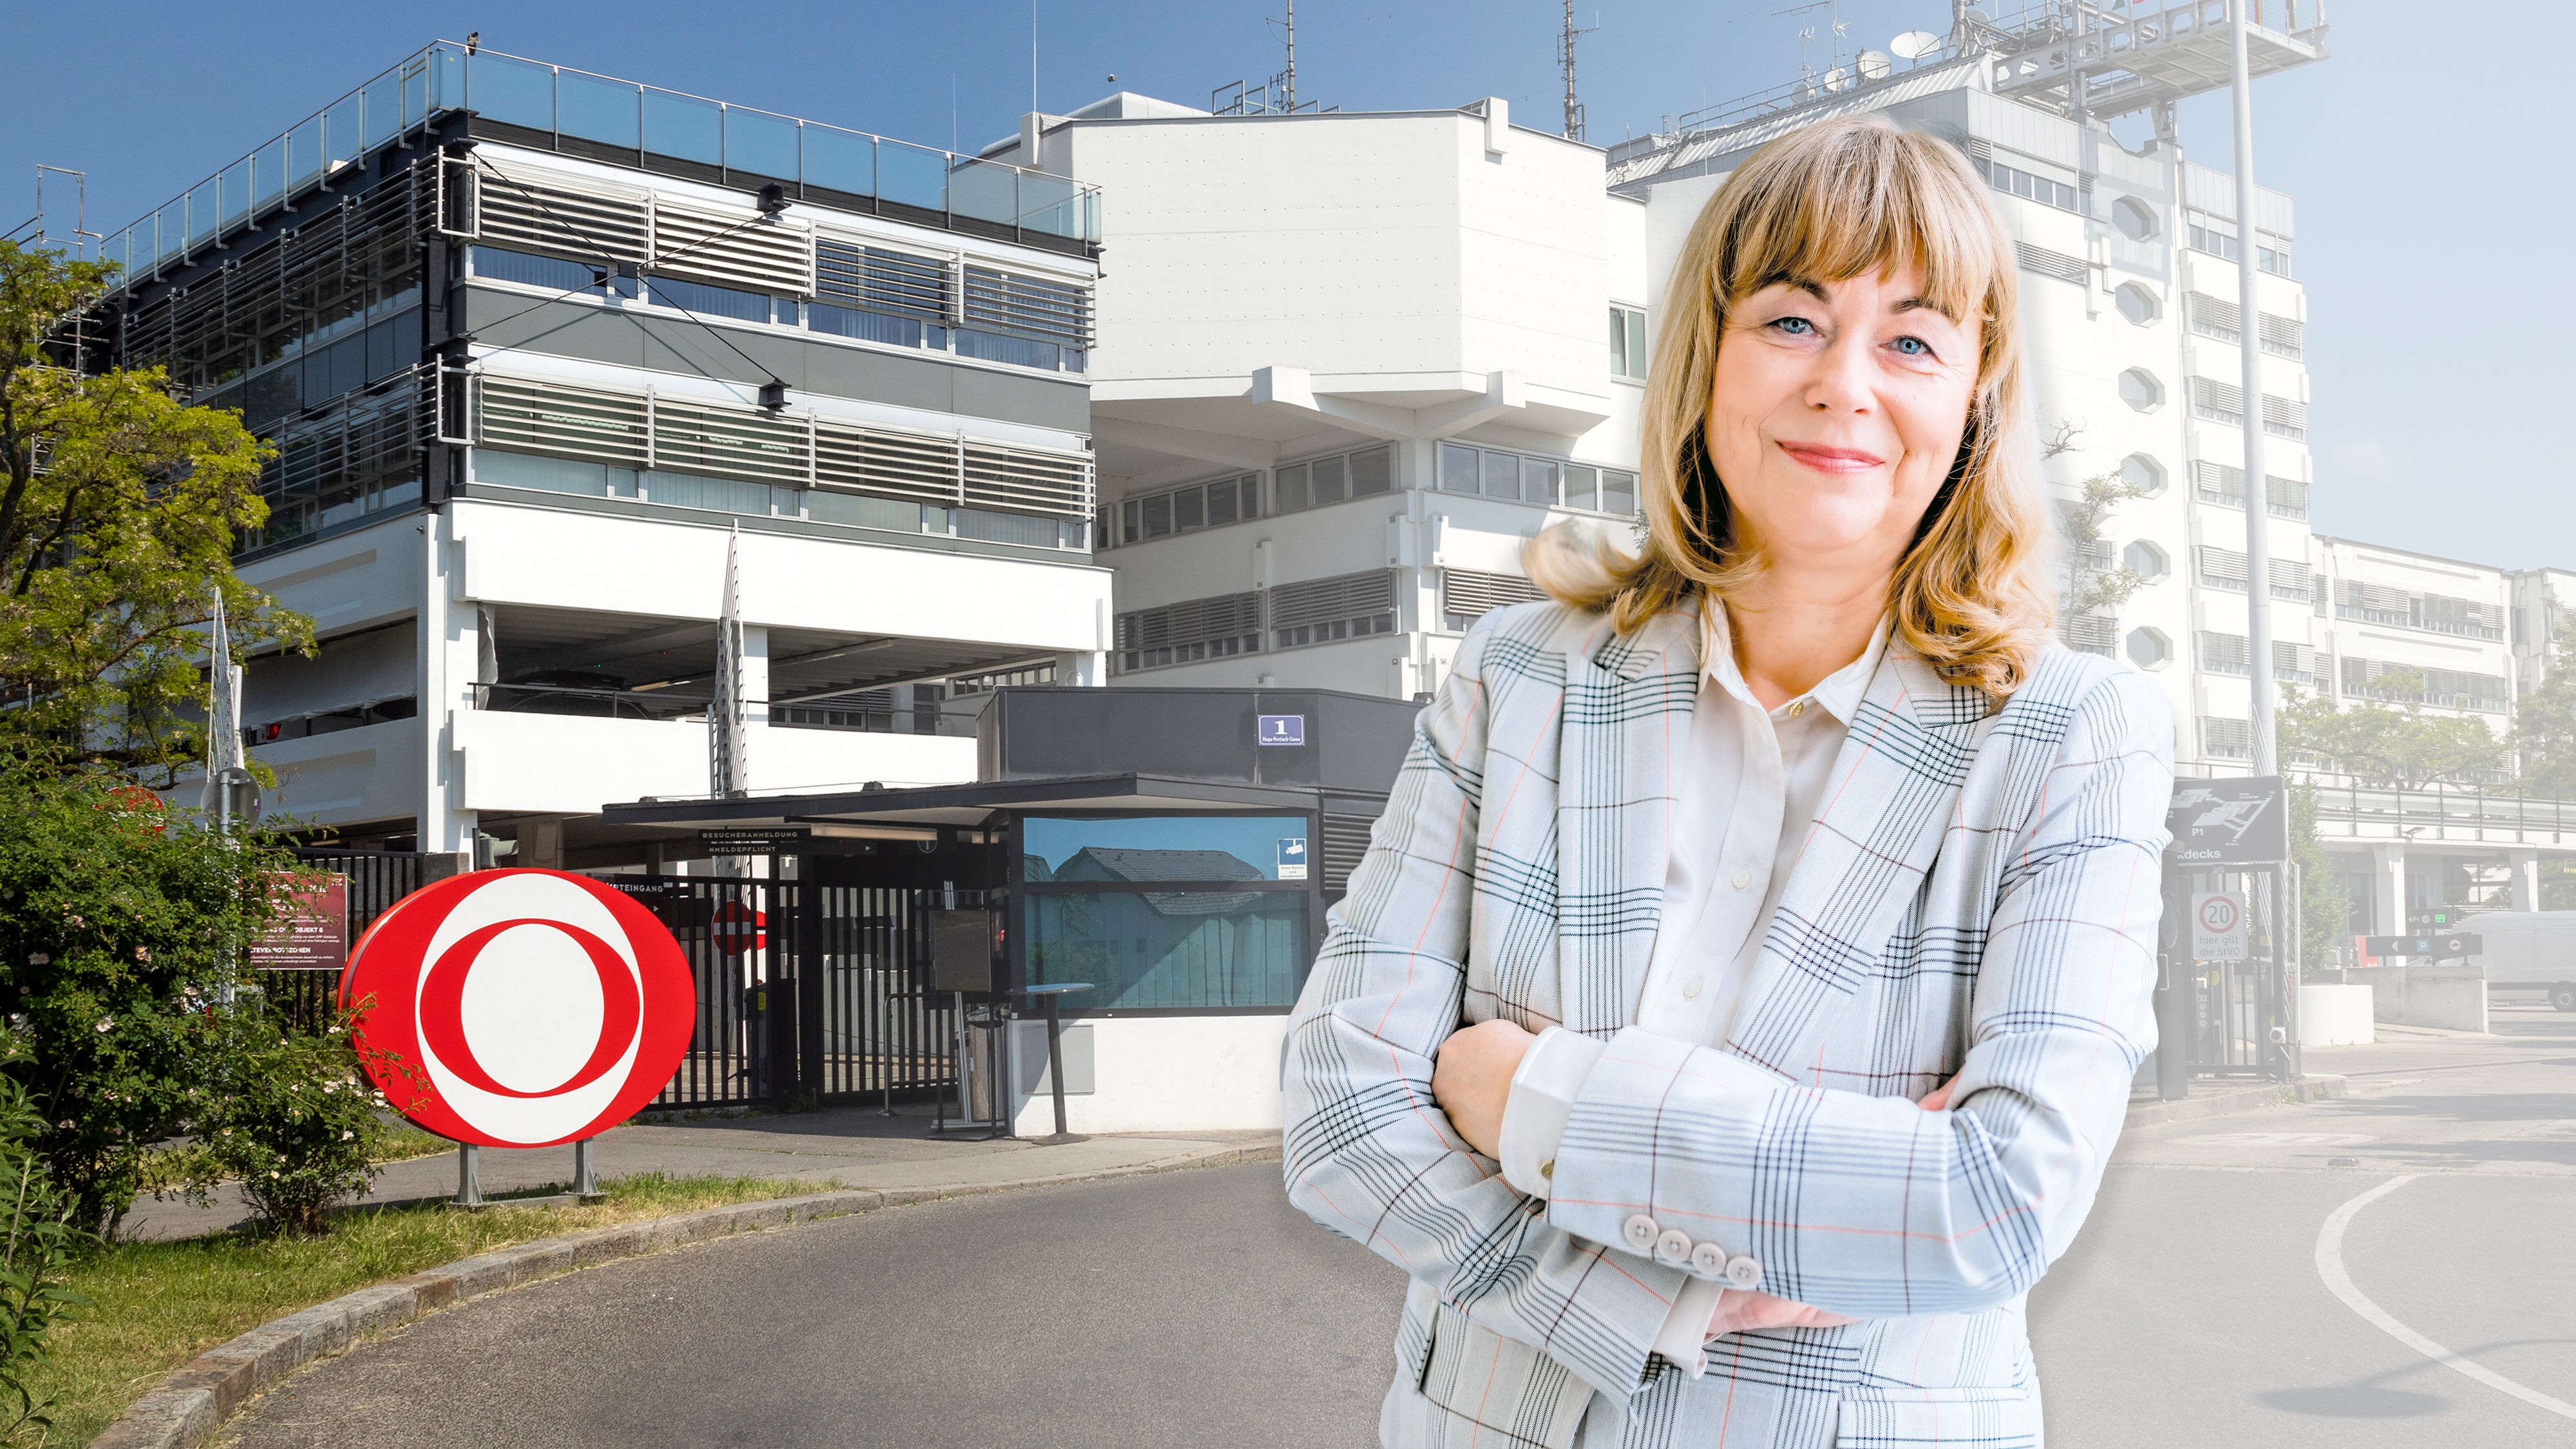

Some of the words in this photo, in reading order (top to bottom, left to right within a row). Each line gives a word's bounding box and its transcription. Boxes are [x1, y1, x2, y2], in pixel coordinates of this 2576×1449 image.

[1274, 720, 1287, 735] 1
[606, 882, 663, 893] PTEINGANG
[2208, 905, 2229, 923] 20
[2200, 935, 2219, 944] hier
[2222, 935, 2239, 945] gilt
[2199, 947, 2214, 956] die
[2217, 947, 2240, 956] StVO
